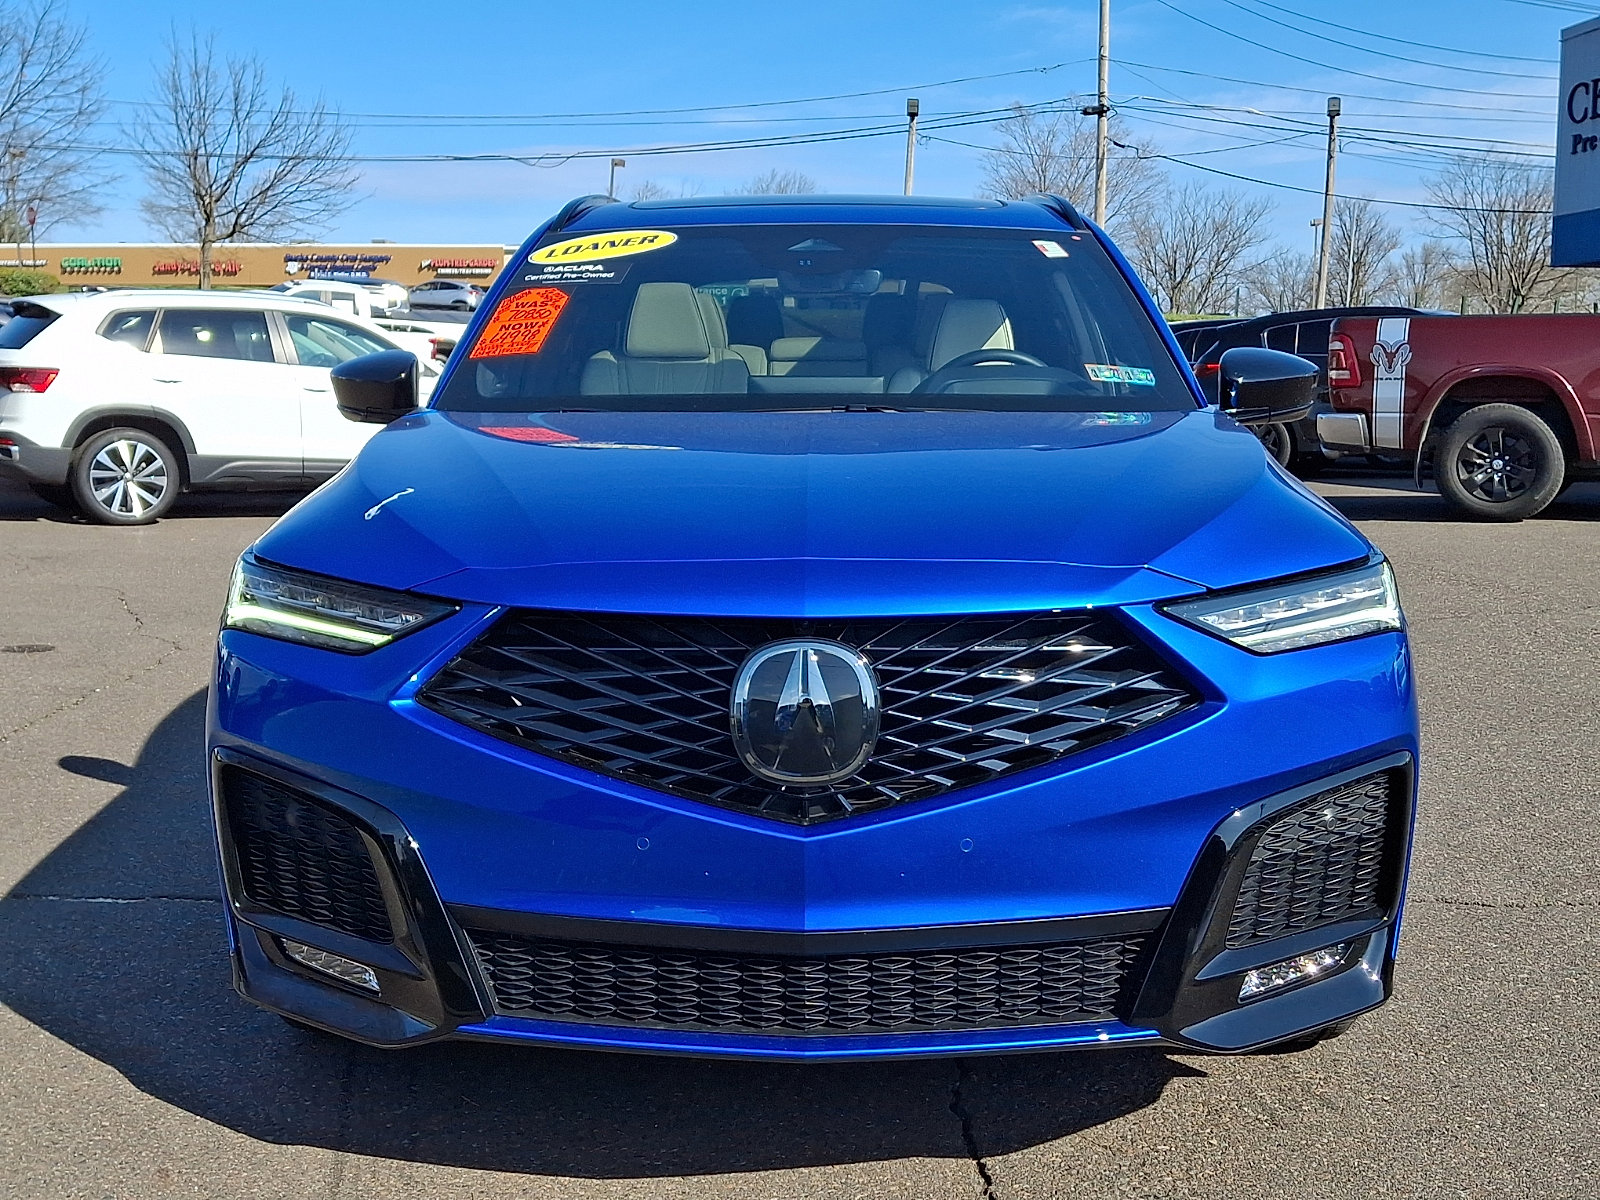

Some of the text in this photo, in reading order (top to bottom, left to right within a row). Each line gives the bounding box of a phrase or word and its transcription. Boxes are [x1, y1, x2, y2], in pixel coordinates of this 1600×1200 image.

[1571, 133, 1598, 155] Pre
[545, 235, 660, 259] LOANER
[553, 264, 604, 272] ACURA
[524, 271, 615, 281] Certified Pre-Owned
[514, 300, 549, 309] WAS
